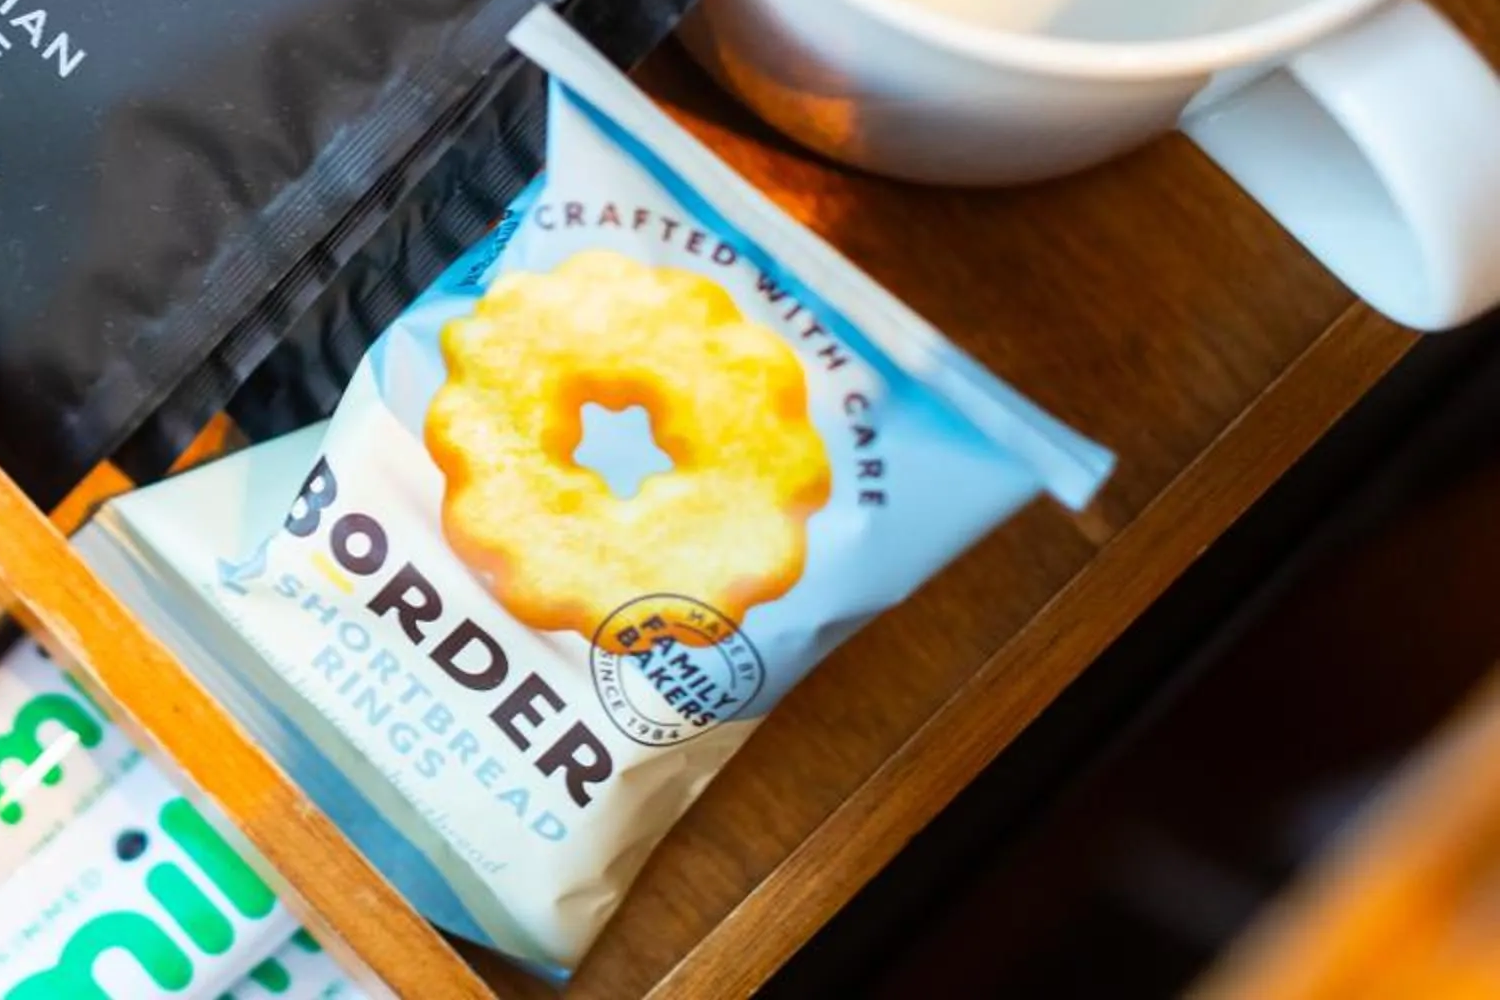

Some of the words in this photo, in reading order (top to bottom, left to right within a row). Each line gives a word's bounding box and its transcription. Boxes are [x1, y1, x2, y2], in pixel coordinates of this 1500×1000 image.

[534, 201, 738, 266] CRAFTED
[756, 272, 849, 371] WITH
[843, 392, 886, 506] CARE
[283, 456, 613, 809] BORDER
[616, 626, 716, 727] BAKERS
[640, 615, 739, 710] FAMILY
[272, 572, 569, 845] SHORTBREAD
[311, 645, 446, 779] RINGS
[626, 717, 680, 740] 1984
